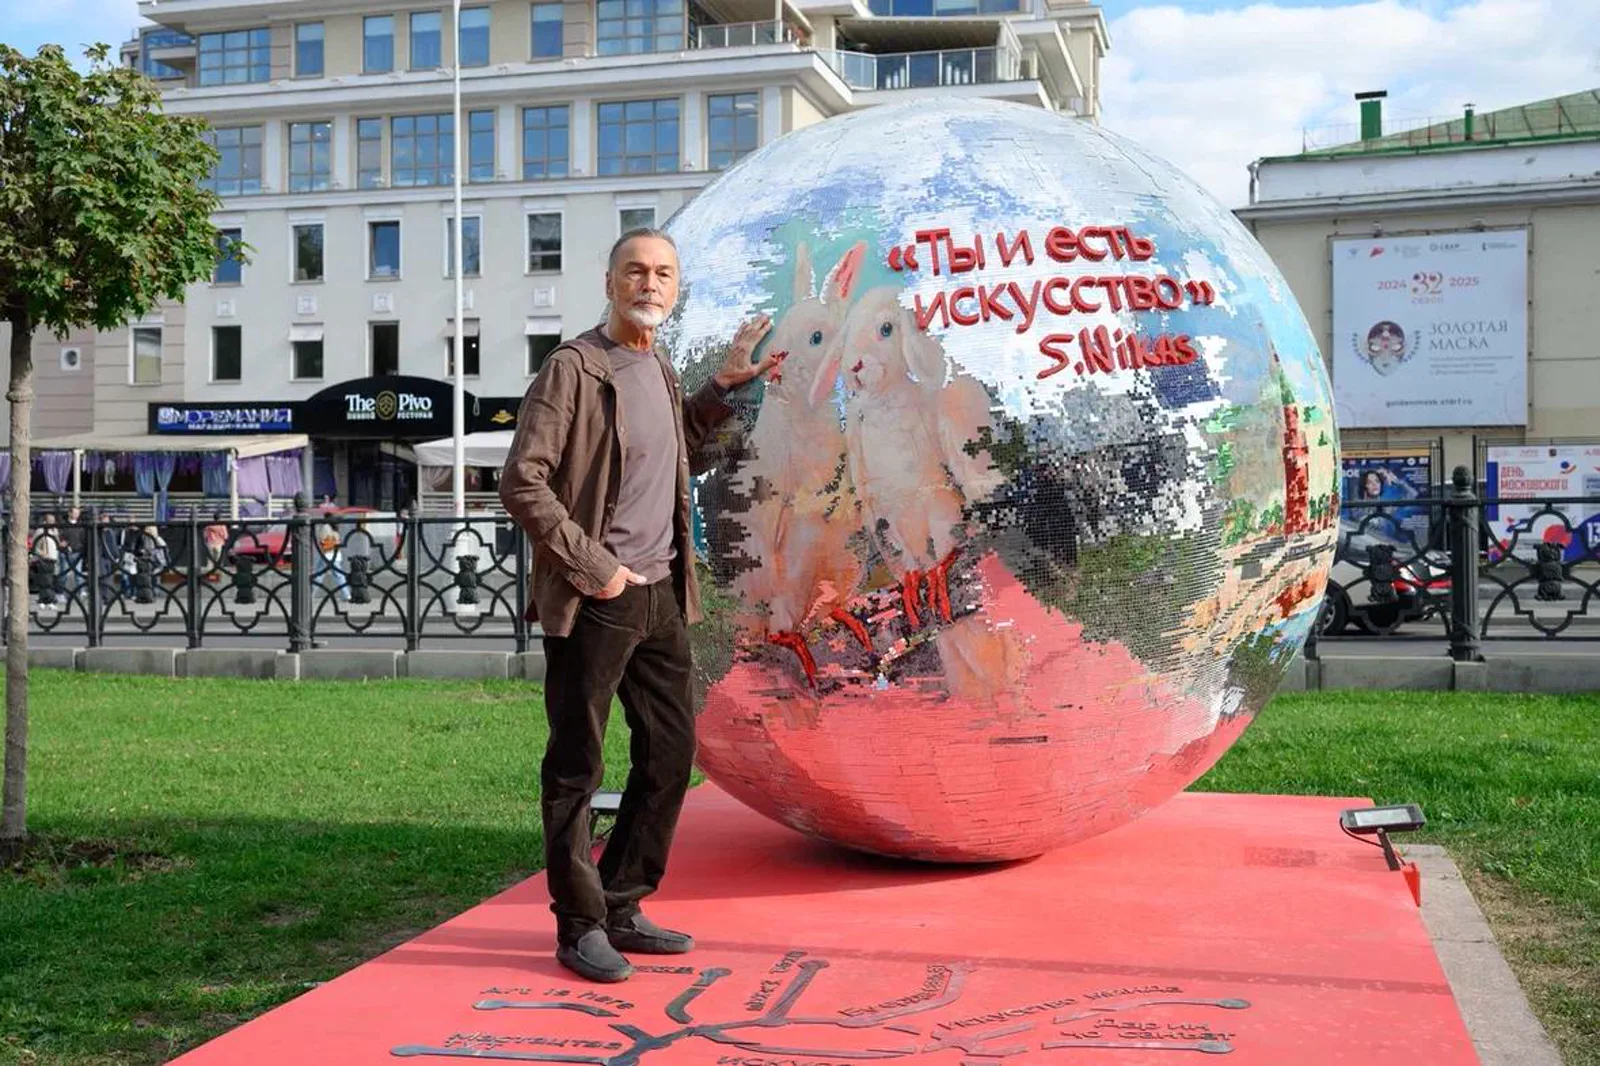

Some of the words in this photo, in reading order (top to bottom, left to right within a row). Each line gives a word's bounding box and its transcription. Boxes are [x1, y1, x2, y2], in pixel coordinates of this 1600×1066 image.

[888, 228, 985, 276] «Ты
[996, 230, 1034, 267] и
[1045, 226, 1156, 263] есть
[1378, 281, 1407, 290] 2024
[1411, 271, 1443, 294] 32
[1450, 276, 1479, 287] 2025
[914, 273, 1216, 334] искусство»
[1429, 320, 1508, 336] ЗОЛОТАЯ
[1429, 337, 1489, 351] МАСКА
[345, 394, 376, 411] The
[400, 394, 433, 411] Pivo
[175, 408, 292, 424] МОРЕМАНИЯ
[480, 986, 533, 995] Art
[577, 990, 635, 1010] here
